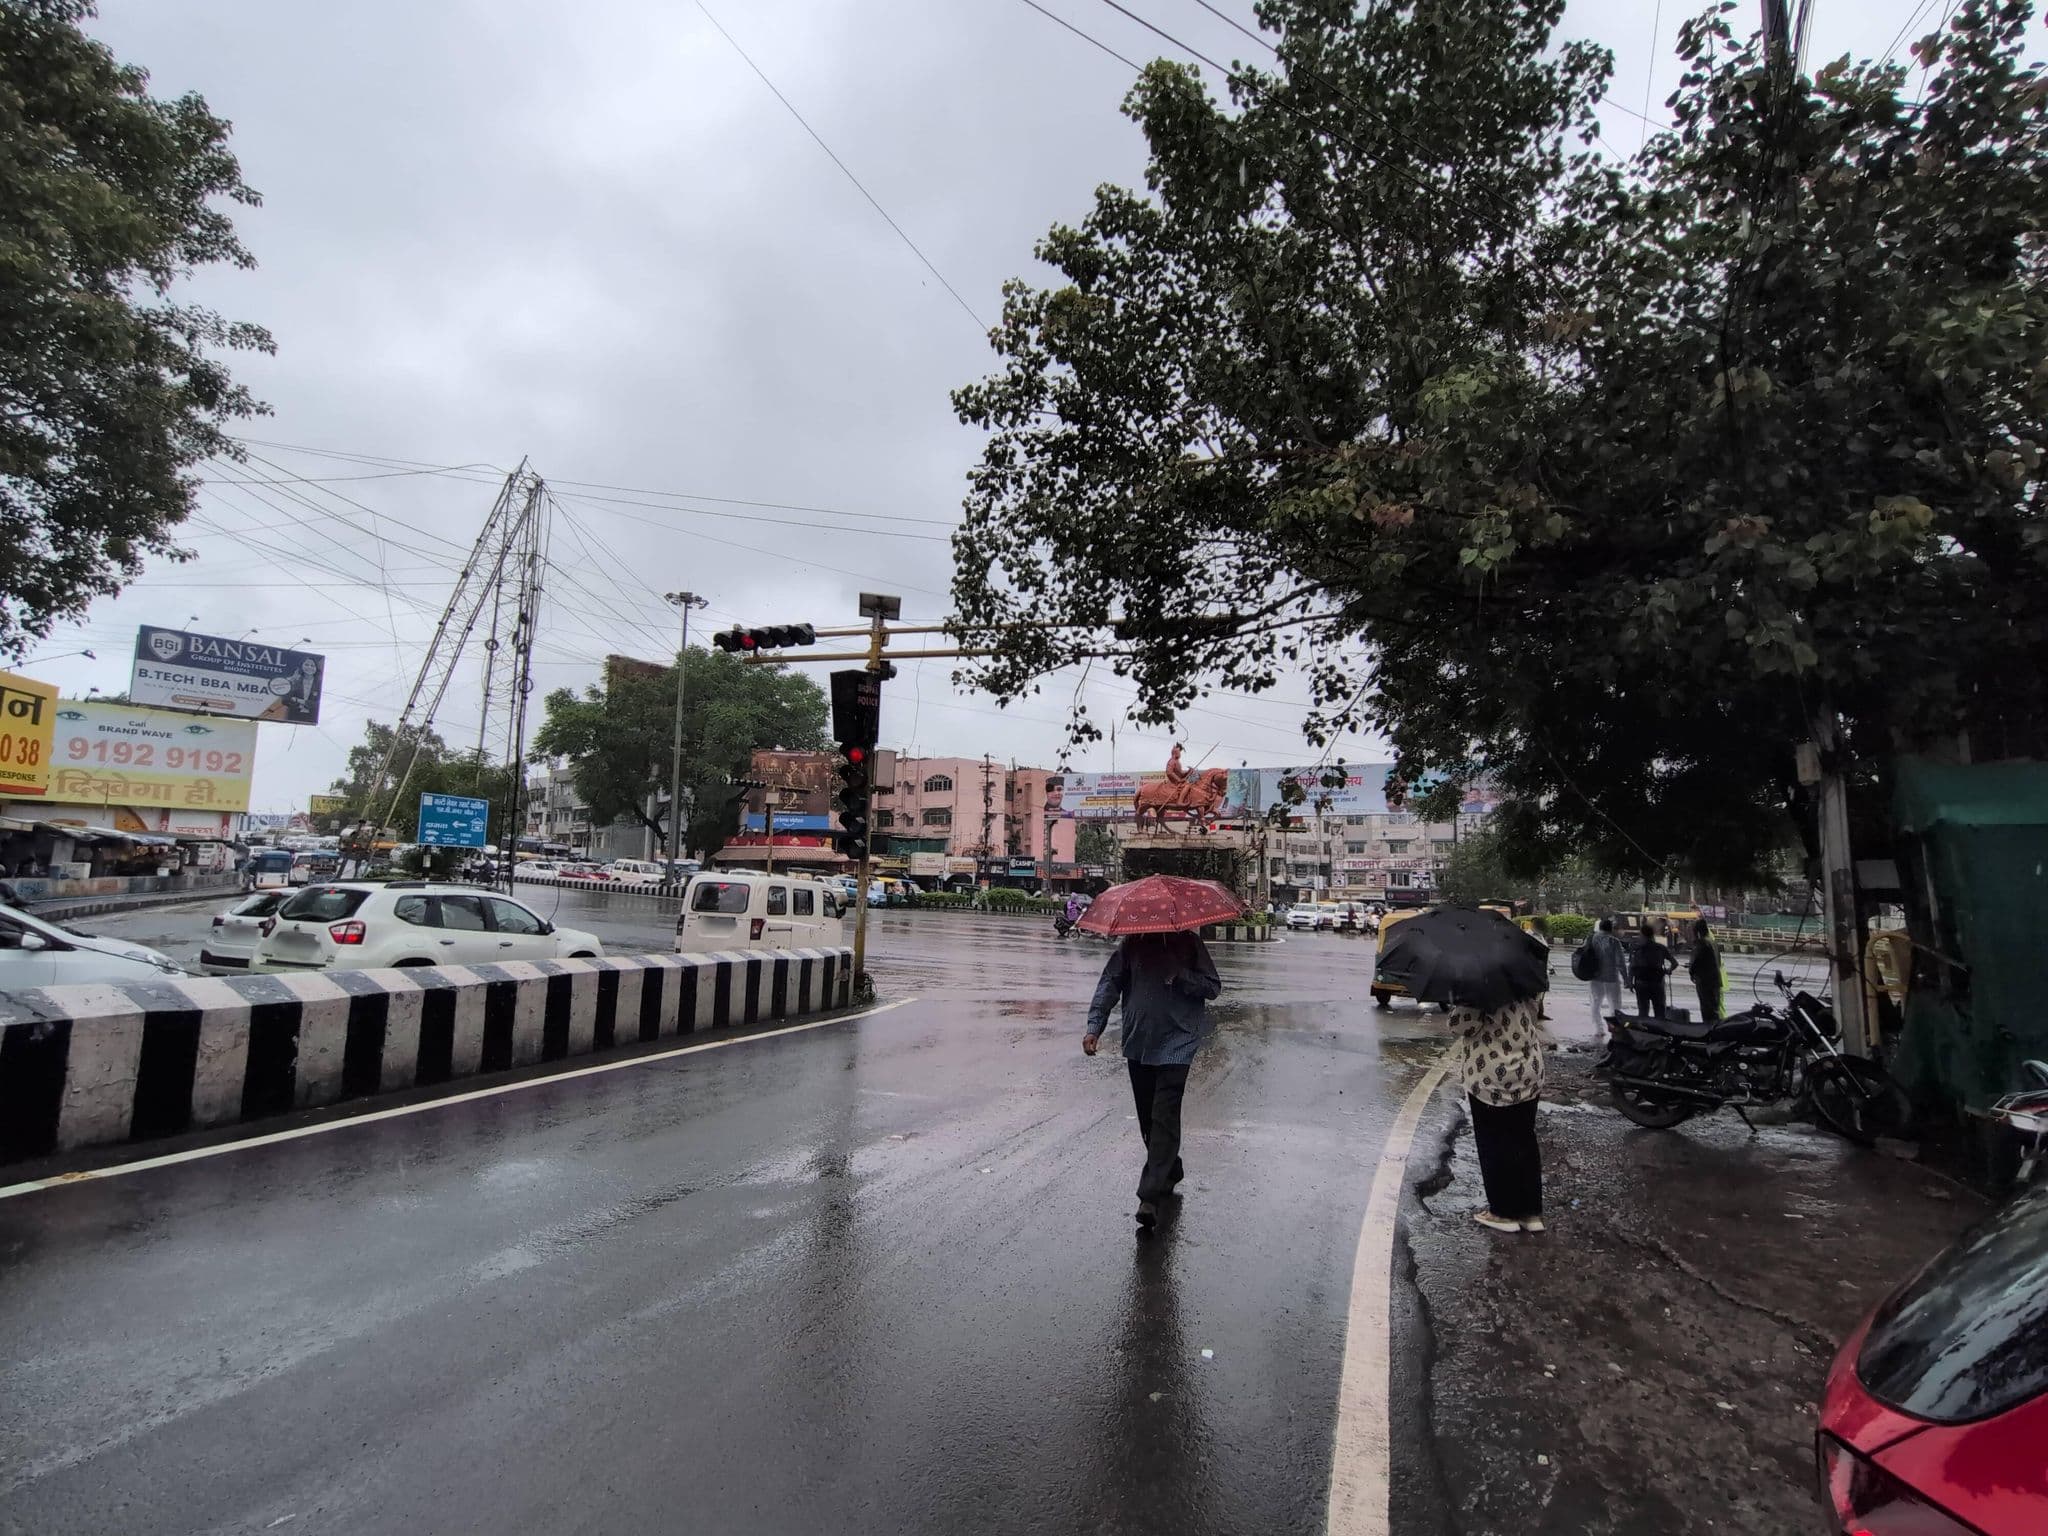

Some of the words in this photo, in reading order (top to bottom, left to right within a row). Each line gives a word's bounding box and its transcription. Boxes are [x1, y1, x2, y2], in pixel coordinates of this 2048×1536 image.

[154, 638, 179, 652] BGI
[189, 636, 287, 667] BANSAL
[191, 654, 222, 664] GROUP
[138, 668, 195, 685] B.TECH
[201, 677, 230, 690] BBA
[237, 682, 269, 695] MBA
[98, 724, 138, 735] BRAND
[142, 729, 173, 739] WAVE
[129, 720, 146, 728] Call
[16, 736, 40, 766] 38
[68, 736, 154, 766] 9192
[166, 747, 242, 773] 9192
[55, 769, 175, 800] दिखेगा
[773, 816, 789, 824] prime
[1346, 860, 1381, 869] TROPHY
[1394, 860, 1423, 868] HOUSE
